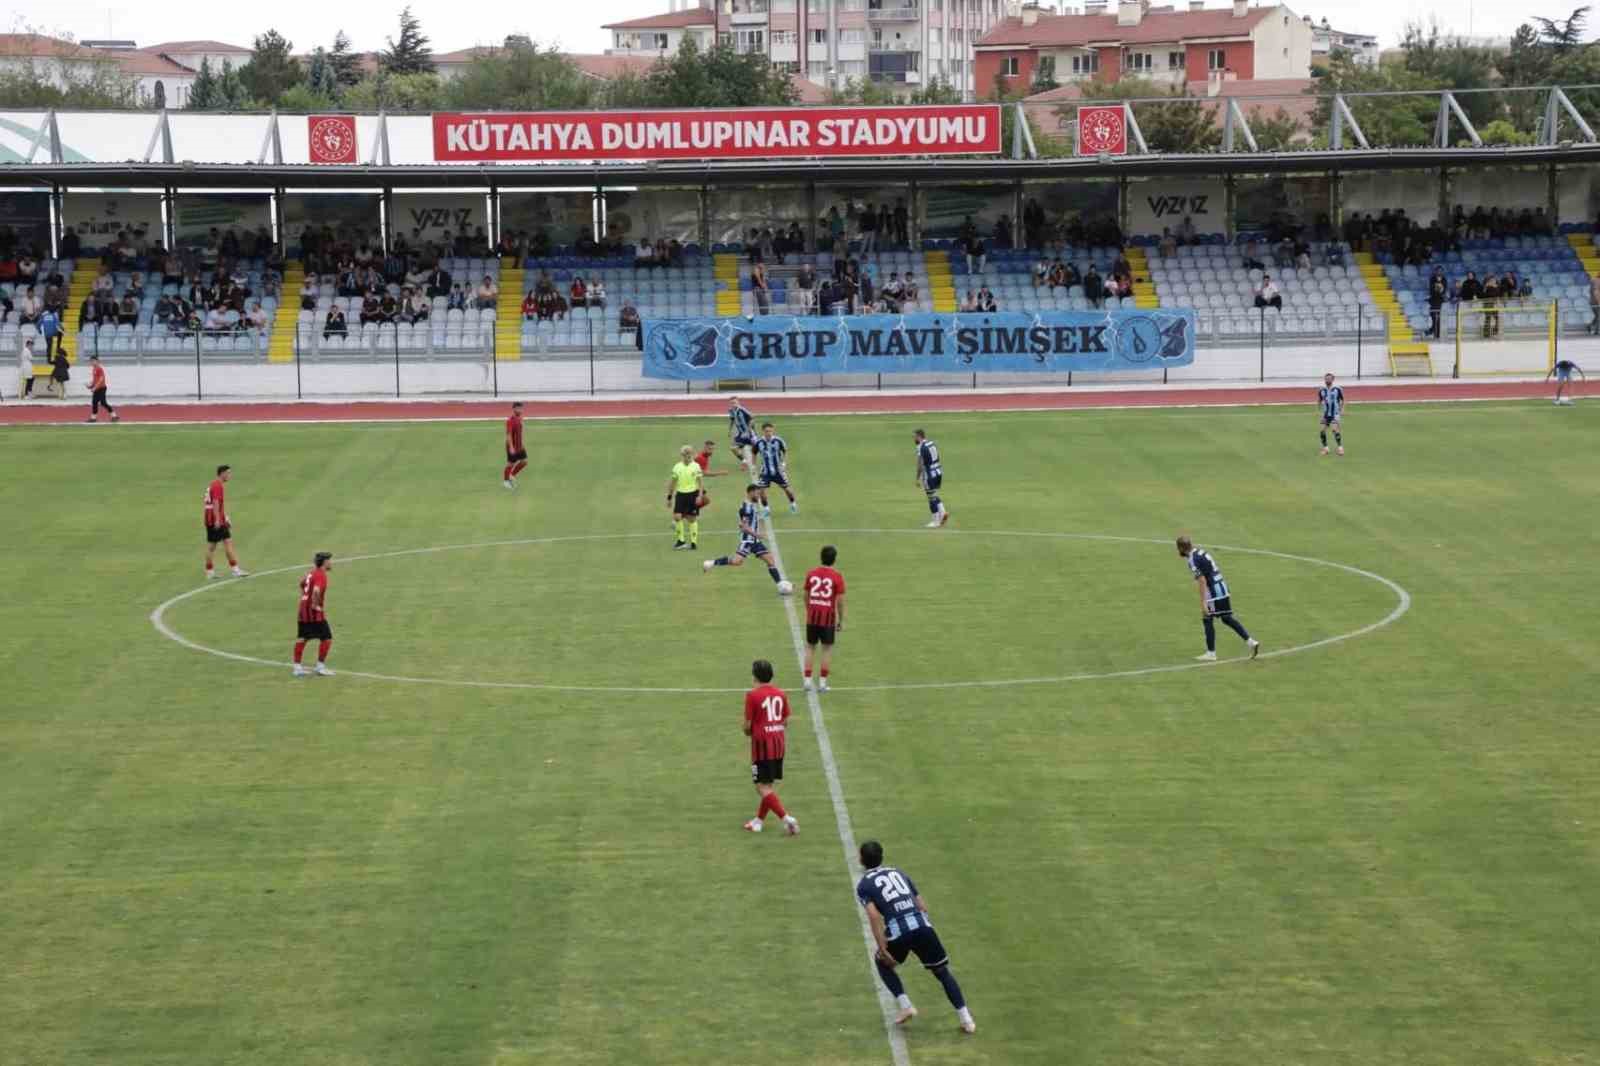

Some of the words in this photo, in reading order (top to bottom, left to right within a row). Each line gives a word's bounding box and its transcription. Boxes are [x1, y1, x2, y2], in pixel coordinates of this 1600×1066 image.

[447, 119, 594, 151] KÜTAHYA
[601, 119, 811, 149] DUMLUPINAR
[817, 115, 986, 147] STADYUMU
[731, 330, 838, 360] GRUP
[849, 319, 945, 357] MAVİ
[956, 318, 1108, 364] ŞİMŞEK
[809, 576, 833, 598] 23
[761, 696, 784, 722] 10
[874, 871, 911, 903] 20
